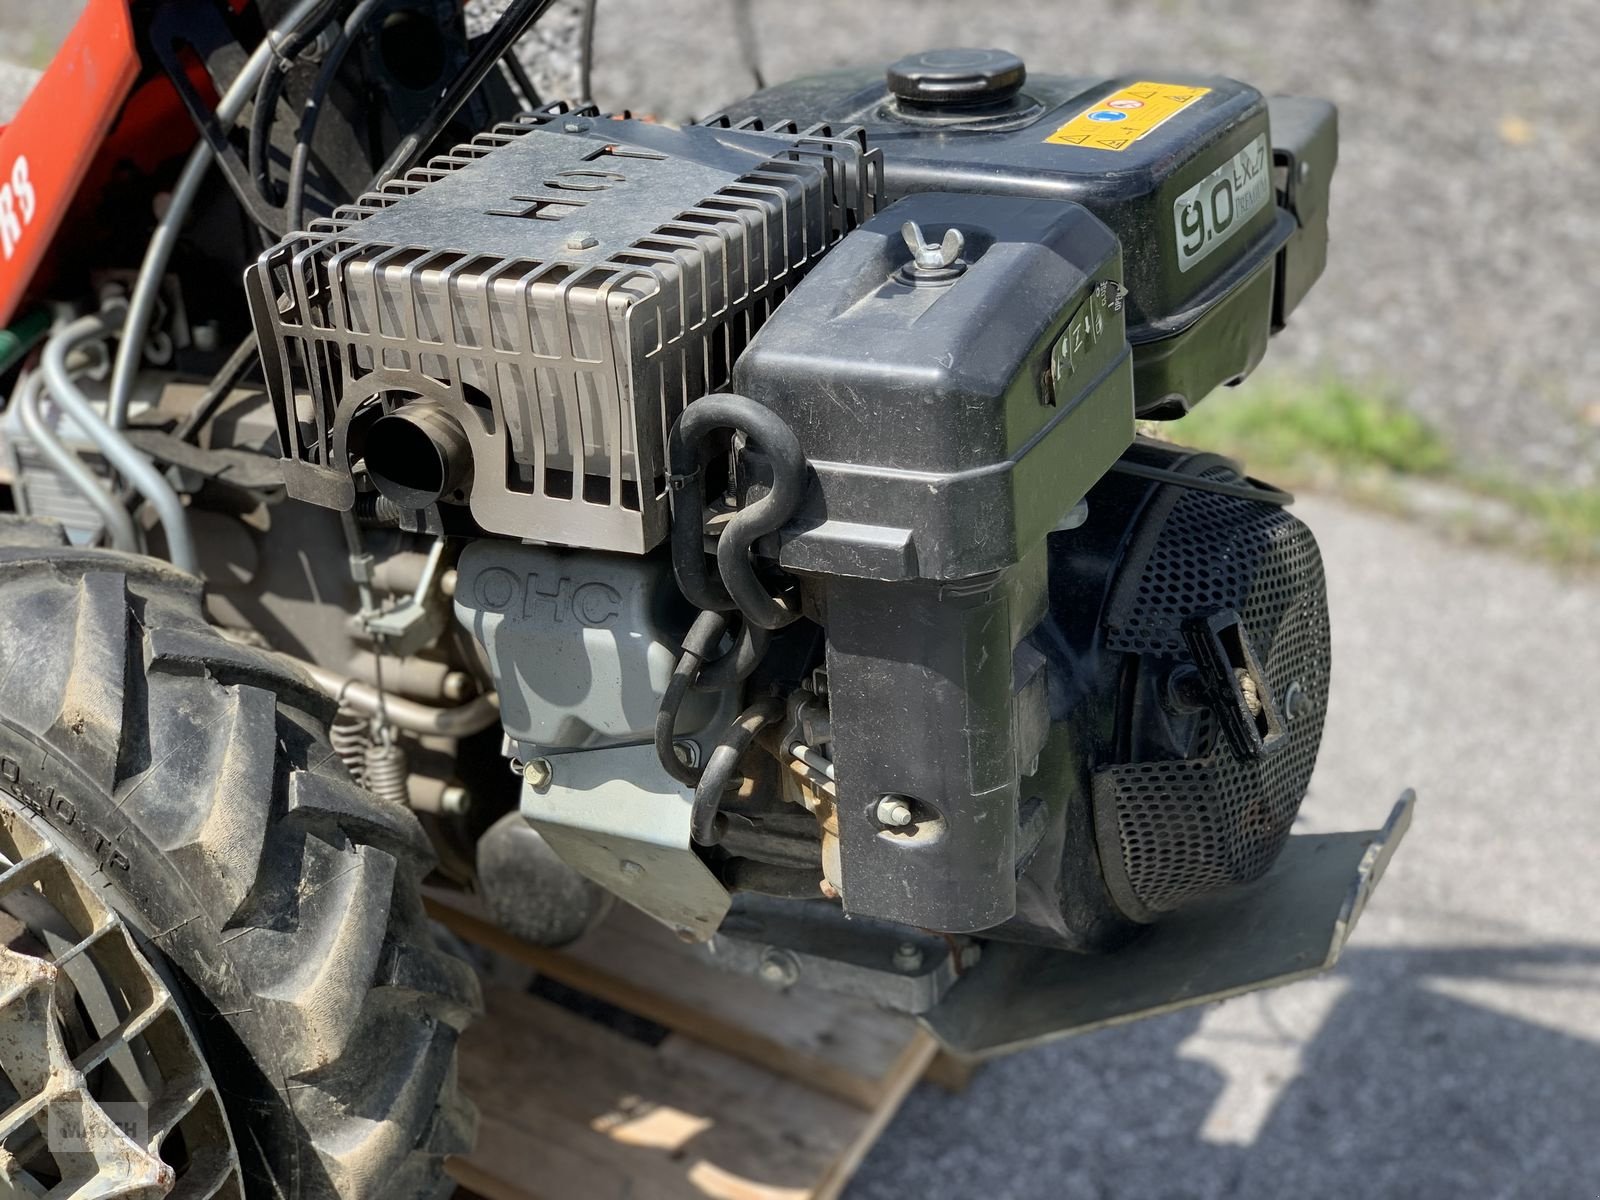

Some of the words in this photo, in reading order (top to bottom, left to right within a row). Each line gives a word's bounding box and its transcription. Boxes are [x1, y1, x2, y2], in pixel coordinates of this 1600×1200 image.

[483, 143, 670, 222] HOT
[1181, 178, 1234, 257] 9.0
[473, 566, 622, 628] OHC
